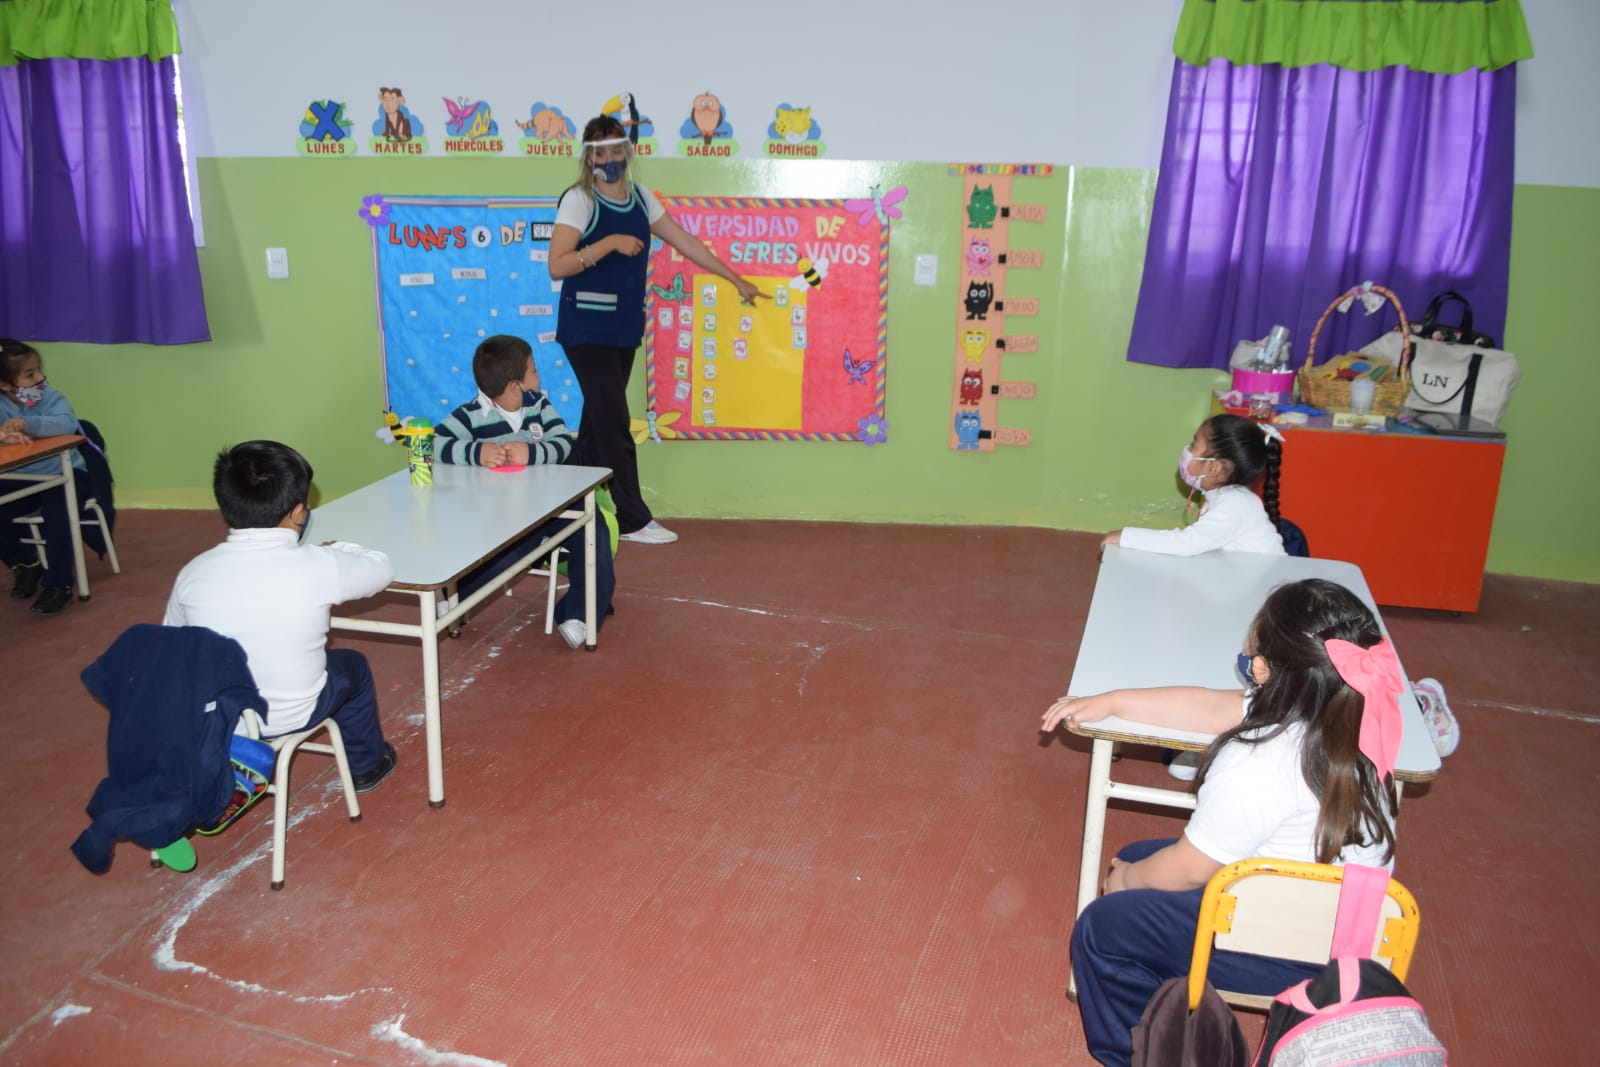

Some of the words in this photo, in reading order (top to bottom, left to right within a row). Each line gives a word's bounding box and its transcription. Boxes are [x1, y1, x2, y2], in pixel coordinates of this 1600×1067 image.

[306, 142, 345, 154] LUNES
[375, 142, 423, 154] MARTES
[769, 143, 818, 157] DOMINGO
[672, 213, 799, 238] IVERSIDAD
[815, 215, 846, 239] DE
[389, 222, 467, 251] LUNES
[477, 230, 486, 243] 6
[500, 221, 527, 246] DE
[729, 240, 798, 264] SERES
[804, 242, 871, 267] VIVOS
[1422, 373, 1449, 389] LN
[529, 422, 544, 440] 9
